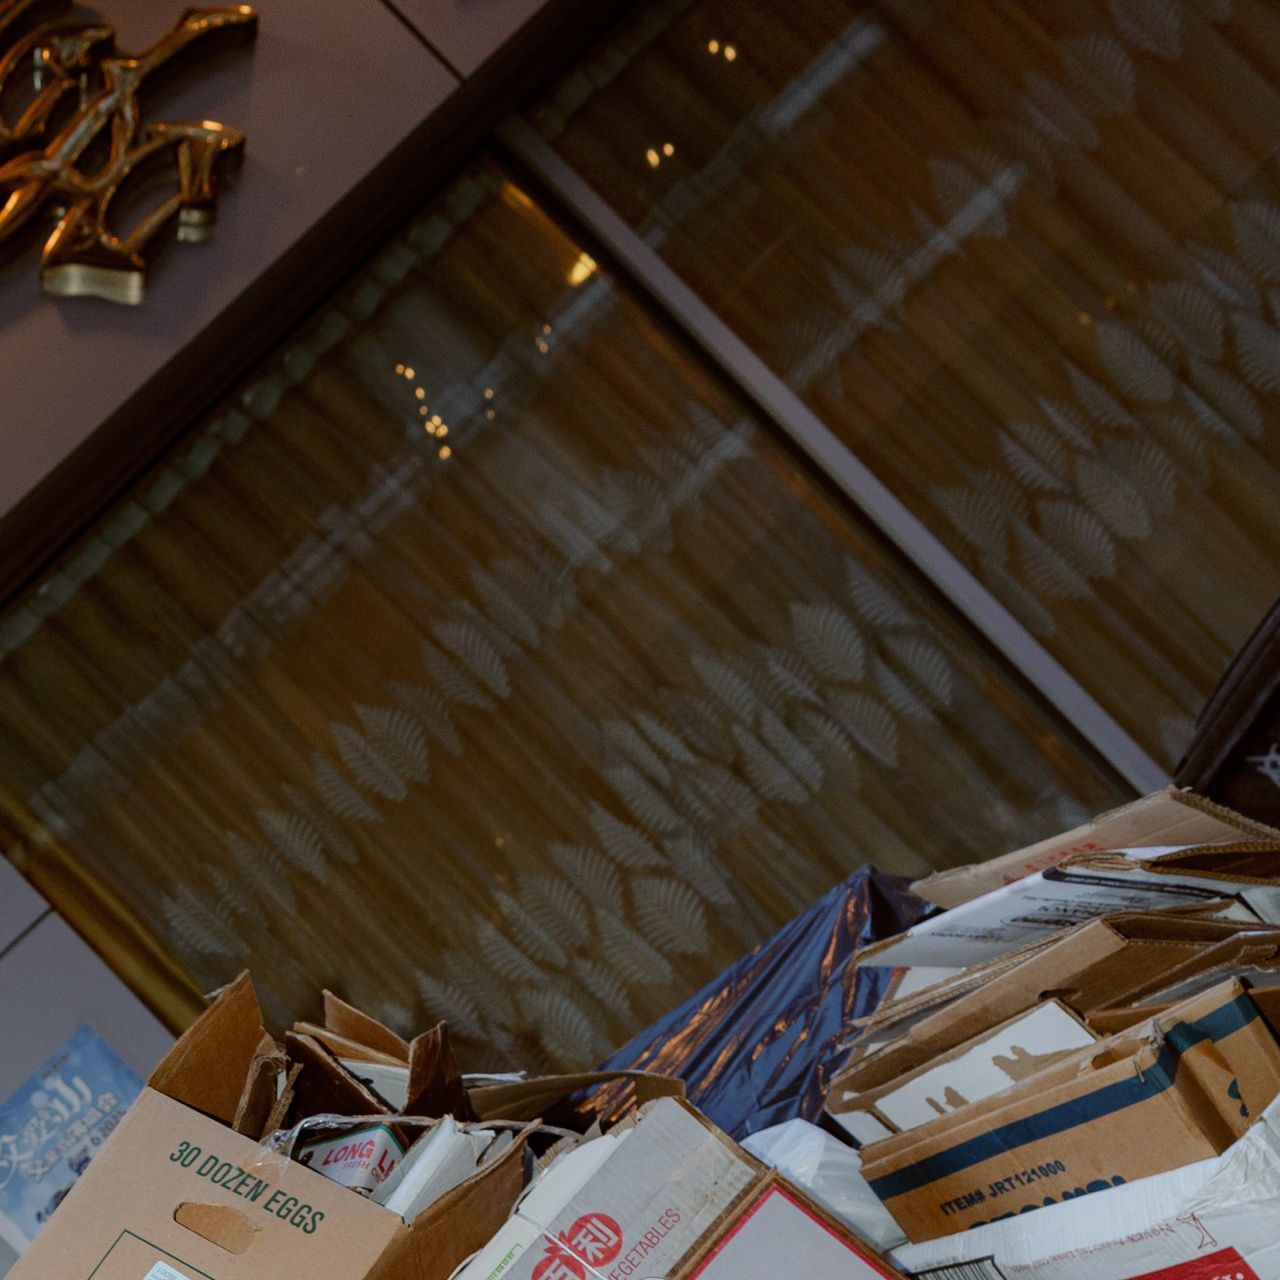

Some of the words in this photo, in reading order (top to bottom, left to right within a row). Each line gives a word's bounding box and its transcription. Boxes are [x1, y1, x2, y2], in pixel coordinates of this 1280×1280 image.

[322, 1139, 378, 1166] LONG
[170, 1142, 201, 1167] 30
[197, 1156, 268, 1201] DOZEN
[263, 1190, 324, 1234] EGGS
[940, 1187, 989, 1216] ITEM#
[989, 1159, 1067, 1197] JRT121000
